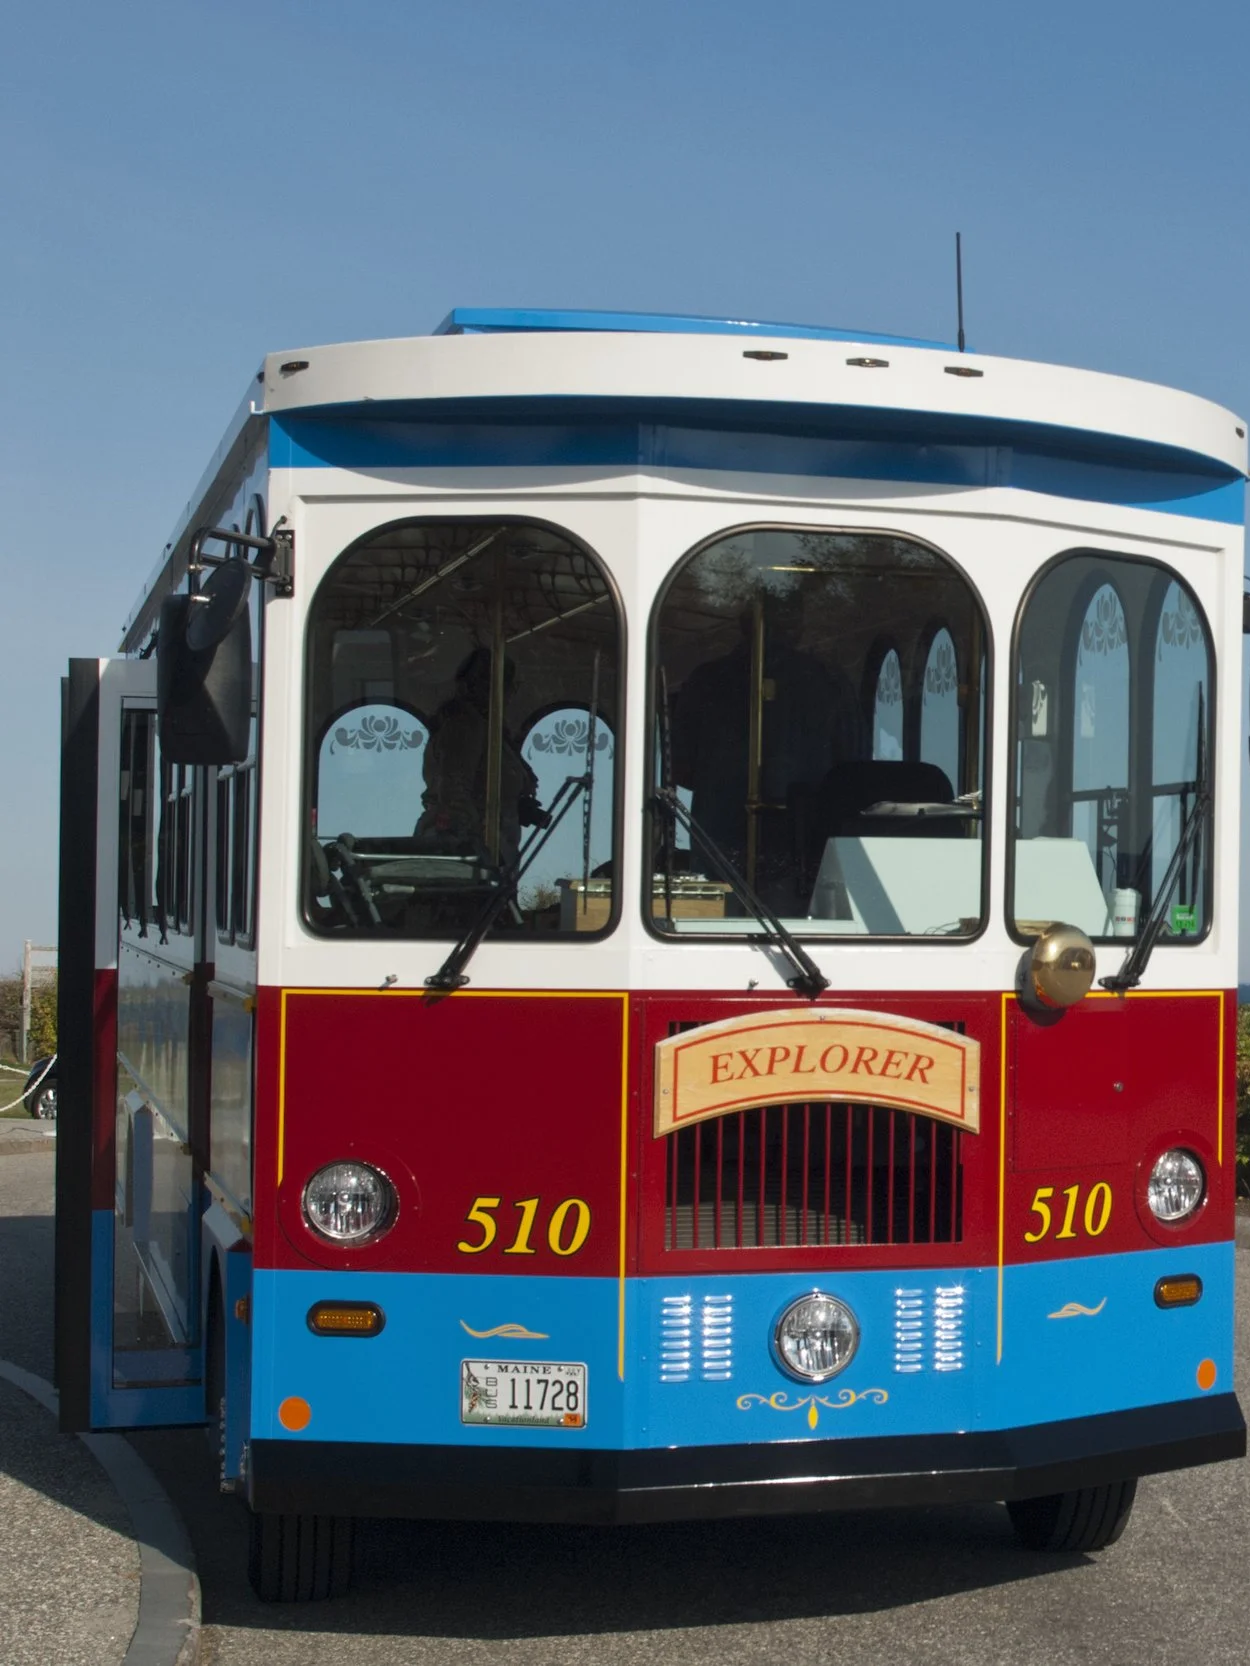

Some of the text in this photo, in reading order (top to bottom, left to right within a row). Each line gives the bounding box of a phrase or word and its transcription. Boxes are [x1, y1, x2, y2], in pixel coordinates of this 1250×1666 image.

[708, 1043, 936, 1085] EXPLORER
[456, 1197, 592, 1256] 510
[1023, 1181, 1113, 1243] 510
[497, 1364, 552, 1375] MAINE
[508, 1377, 579, 1412] 11728
